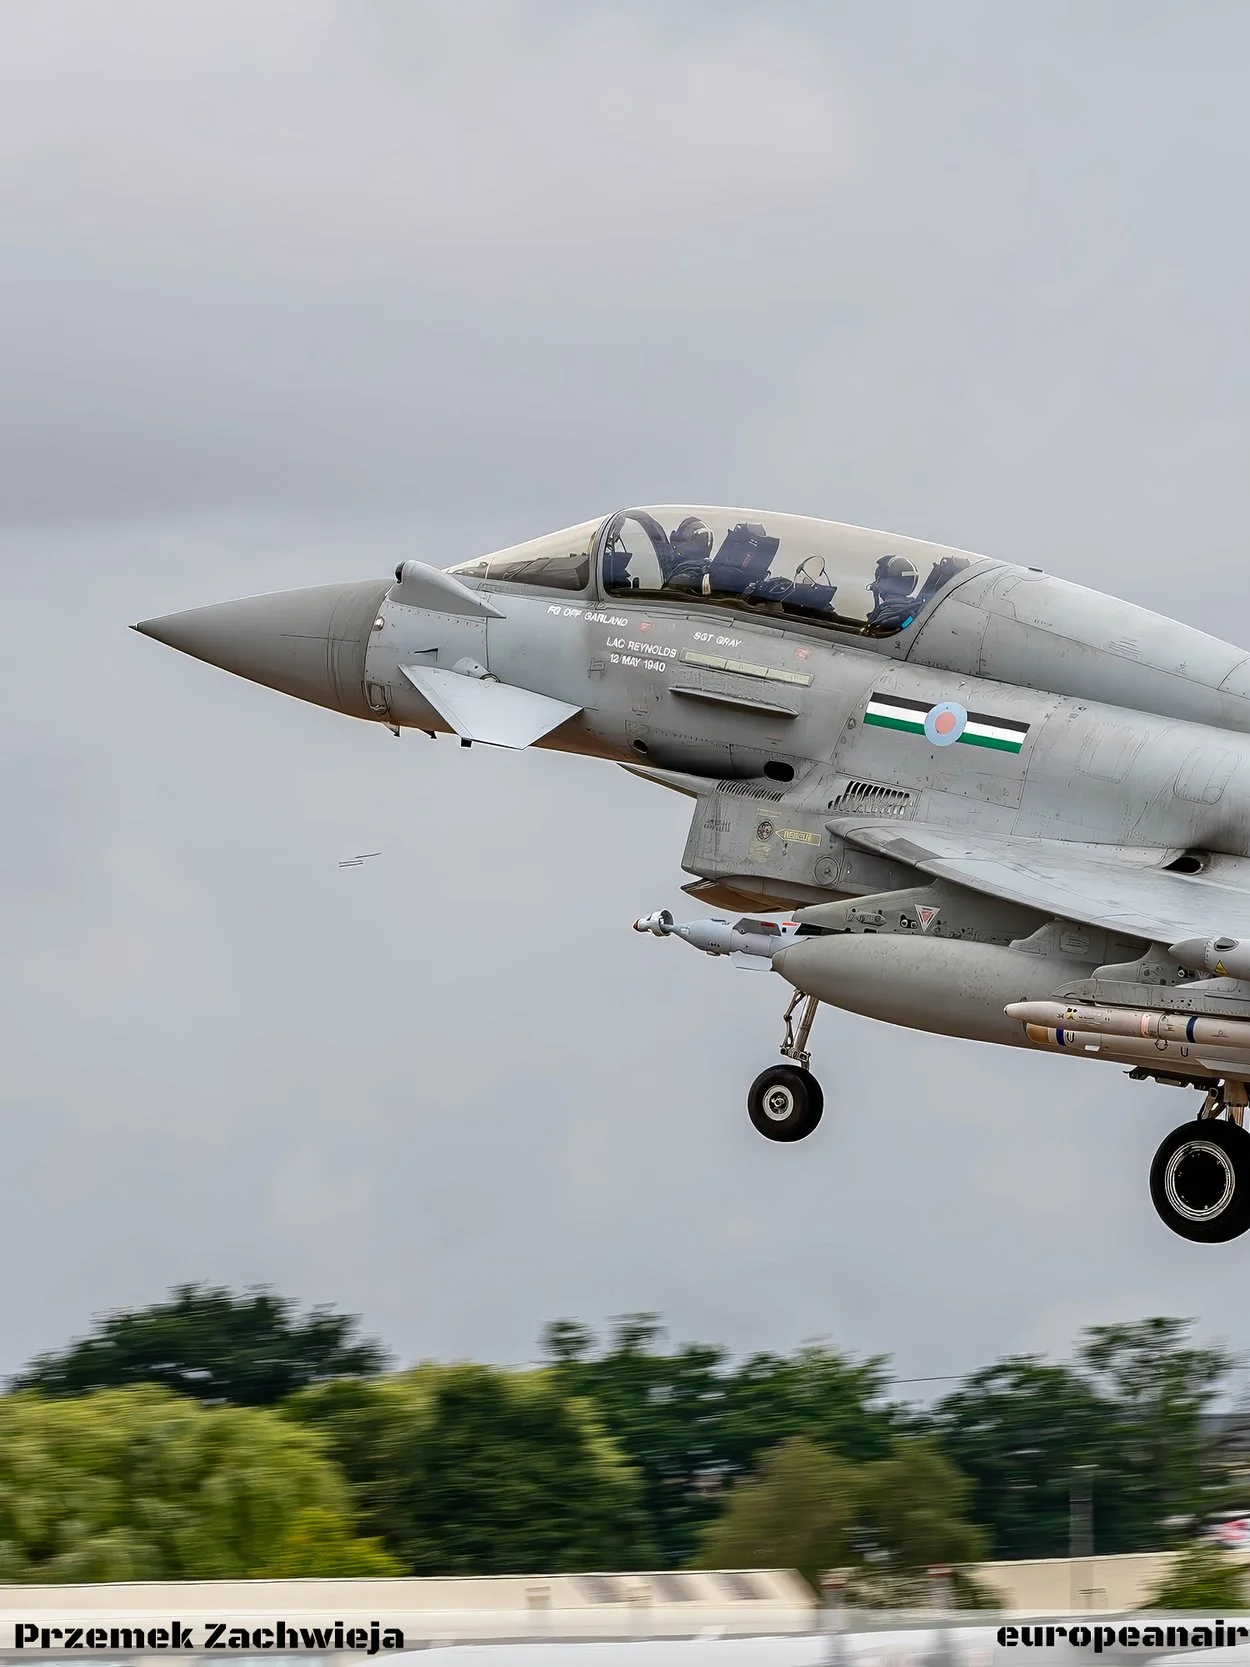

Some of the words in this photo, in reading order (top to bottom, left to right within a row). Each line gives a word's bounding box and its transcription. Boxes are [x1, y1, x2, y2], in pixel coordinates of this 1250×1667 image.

[584, 612, 628, 627] GARLAND
[606, 636, 626, 649] LAC
[628, 640, 677, 658] REYNOLDS
[693, 632, 714, 643] SGT
[716, 636, 742, 648] GRAY
[610, 653, 620, 664] 12
[622, 655, 641, 667] MAY
[643, 659, 666, 673] 1940
